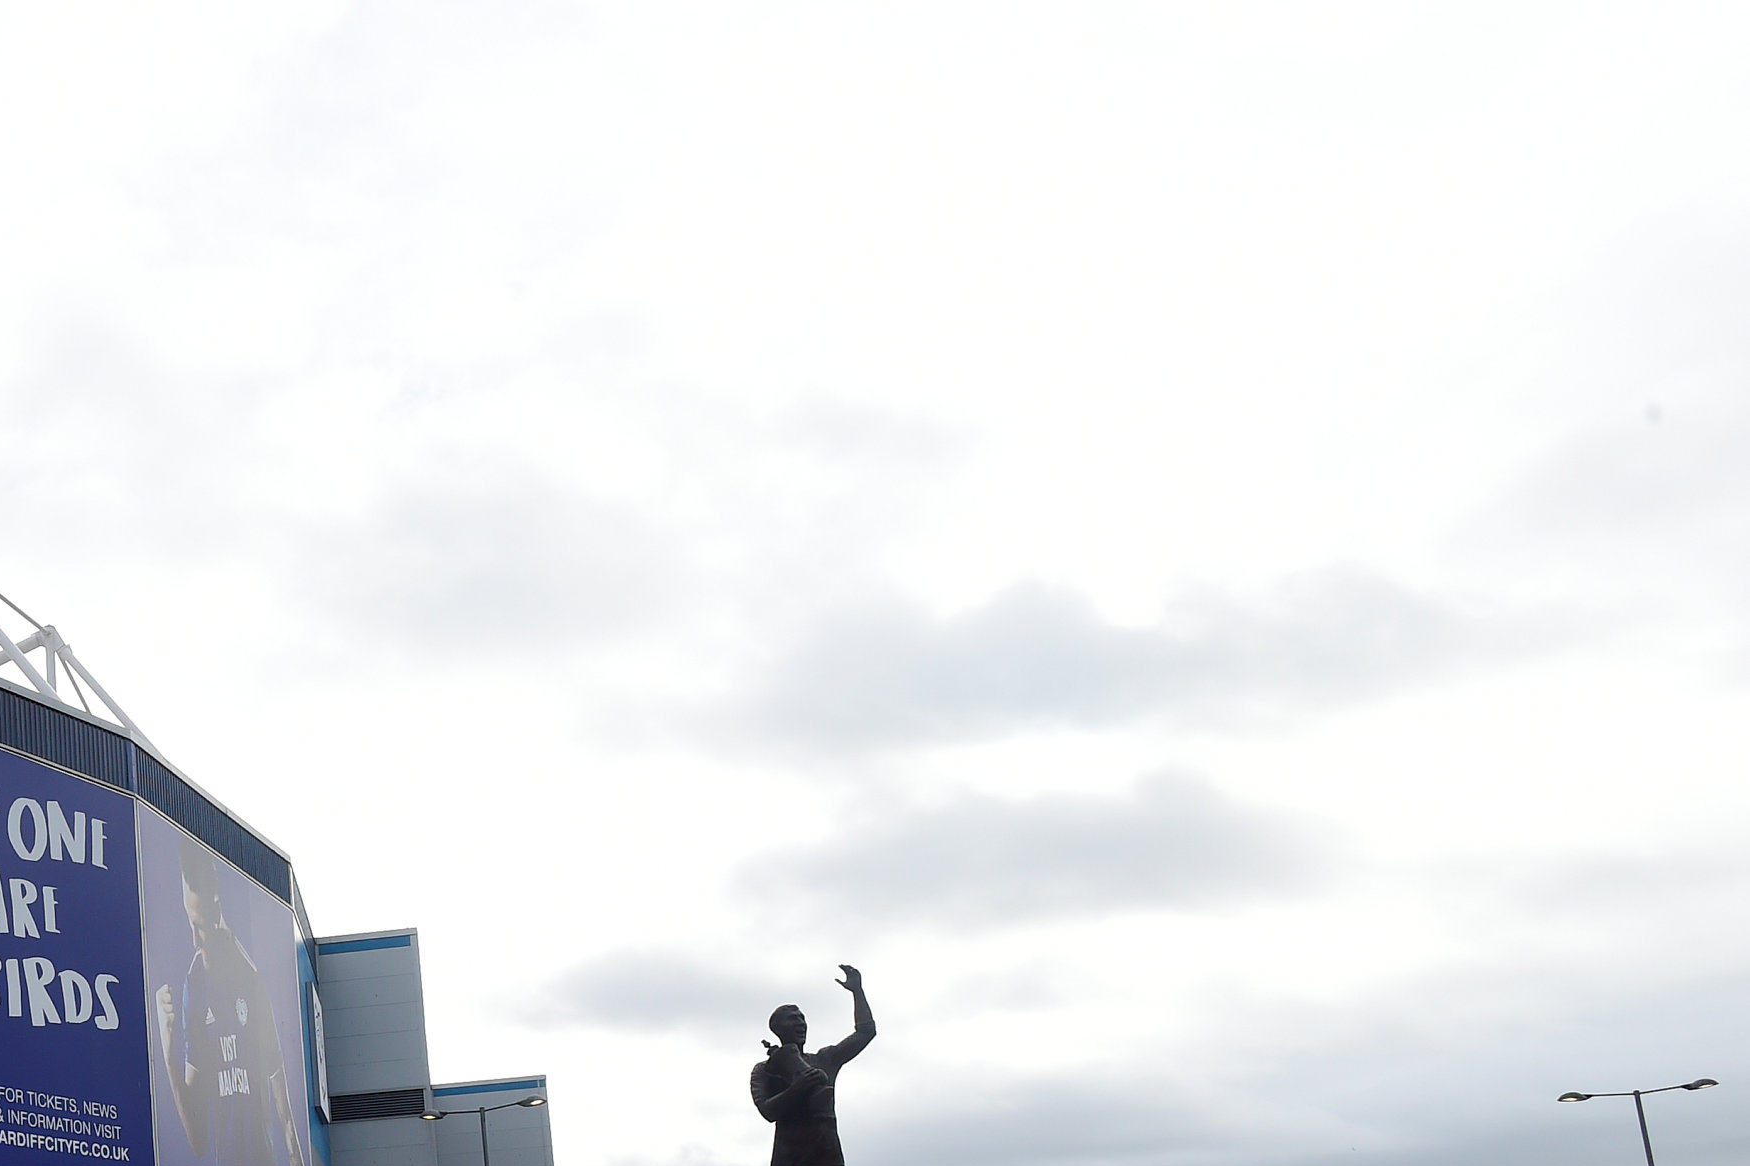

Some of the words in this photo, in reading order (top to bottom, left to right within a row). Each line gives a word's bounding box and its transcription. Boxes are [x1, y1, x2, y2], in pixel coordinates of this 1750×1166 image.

[8, 797, 109, 870] ONE
[26, 1091, 81, 1116] TICKETS,
[83, 1101, 118, 1120] NEWS
[7, 1109, 91, 1134] INFORMATION
[93, 1123, 121, 1140] VISIT
